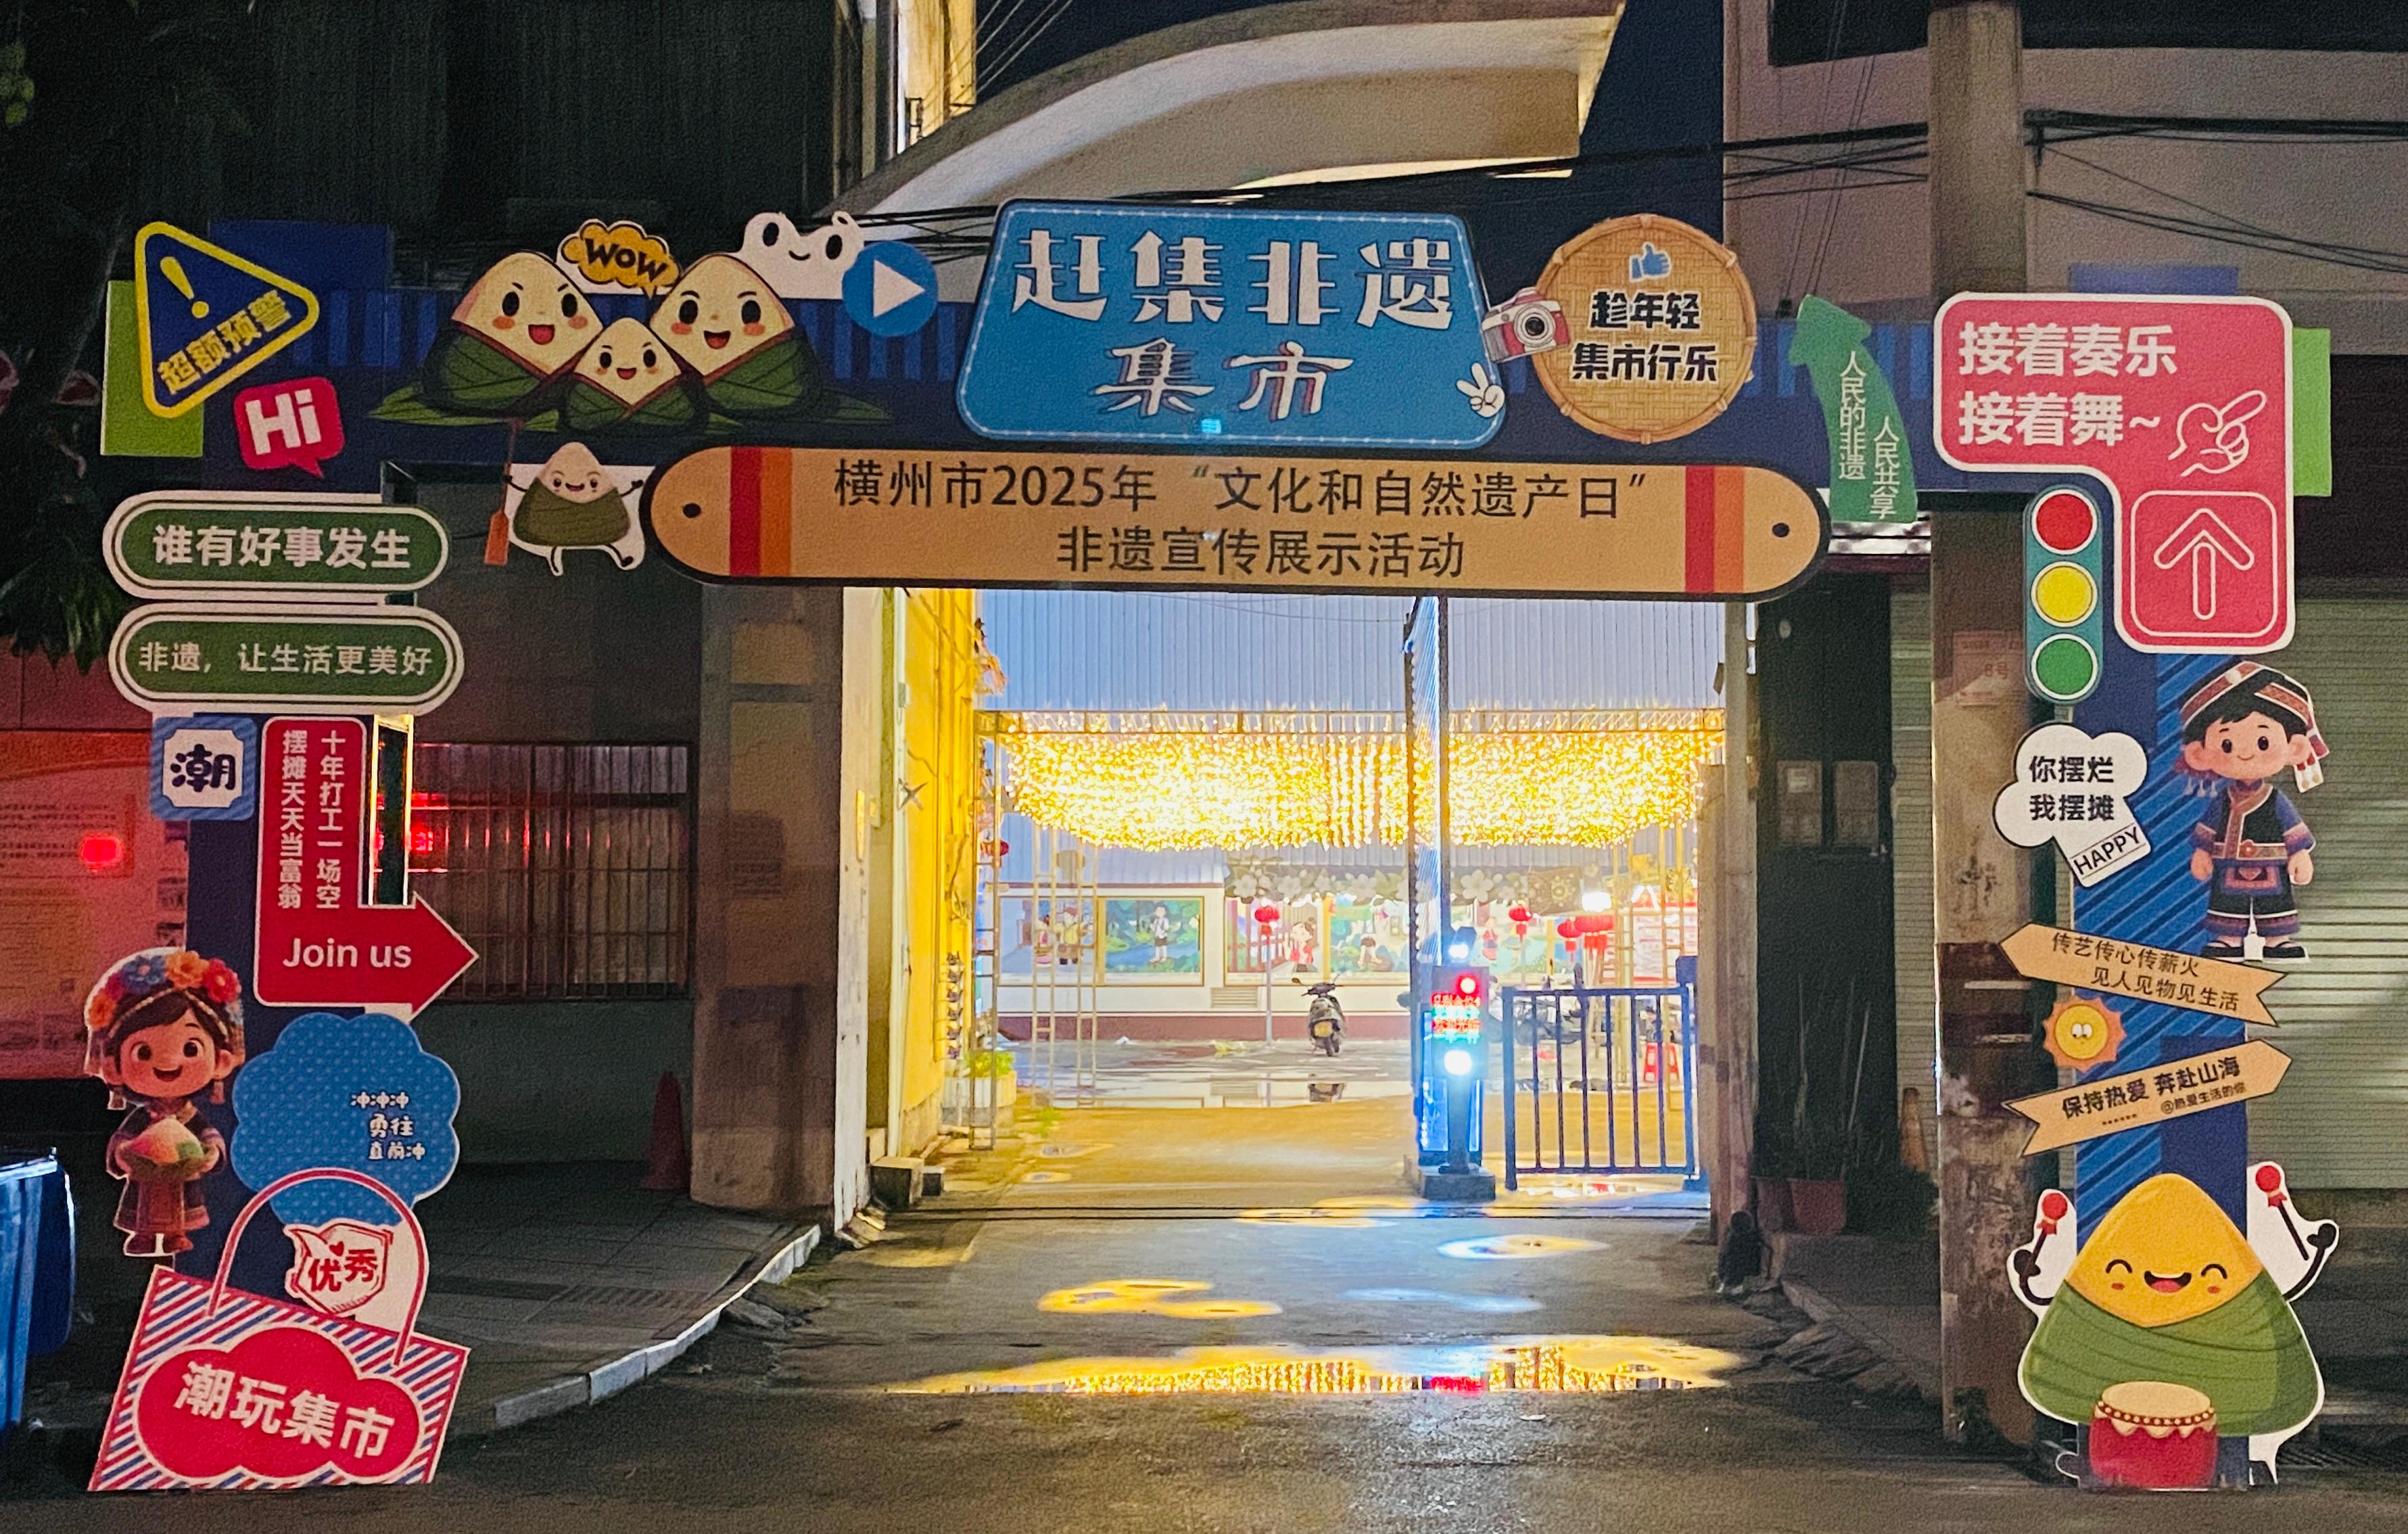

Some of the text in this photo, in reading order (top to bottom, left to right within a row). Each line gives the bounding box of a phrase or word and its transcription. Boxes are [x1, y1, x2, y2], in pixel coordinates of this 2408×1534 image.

[584, 239, 668, 283] WOW
[1012, 229, 1454, 330] 赶集非遗
[1589, 290, 1700, 330] 趁年轻
[157, 289, 292, 394] 超额预警
[1572, 342, 1718, 382] 集市行乐
[1958, 321, 2177, 377] 接着奏乐
[1094, 336, 1354, 422] 集市
[244, 388, 322, 456] Hi
[1839, 350, 1866, 480] 人民的非遗
[1869, 416, 1901, 520] 人民共享
[153, 525, 411, 570] 谁有好事发生
[1057, 526, 1465, 578] 非遗宣传展示活动
[169, 743, 237, 793] 潮
[2029, 756, 2115, 785] 你摆烂
[278, 730, 308, 909] 摆摊天天当富翁
[316, 730, 347, 909] 十年打工一场空
[2029, 794, 2115, 822] 我摆摊
[2073, 826, 2140, 875] HAPPY
[282, 937, 412, 968] Join us
[2052, 932, 2199, 977] 传艺传心传薪火
[2091, 967, 2240, 1012] 见人见物见生活
[350, 1091, 410, 1109] 冲冲冲
[2062, 1056, 2241, 1119] 保持热爱 奔赴山海
[369, 1113, 414, 1138] 勇往
[368, 1141, 426, 1161] 直前冲
[308, 1248, 378, 1292] 优秀
[173, 1360, 395, 1459] 潮玩集市
